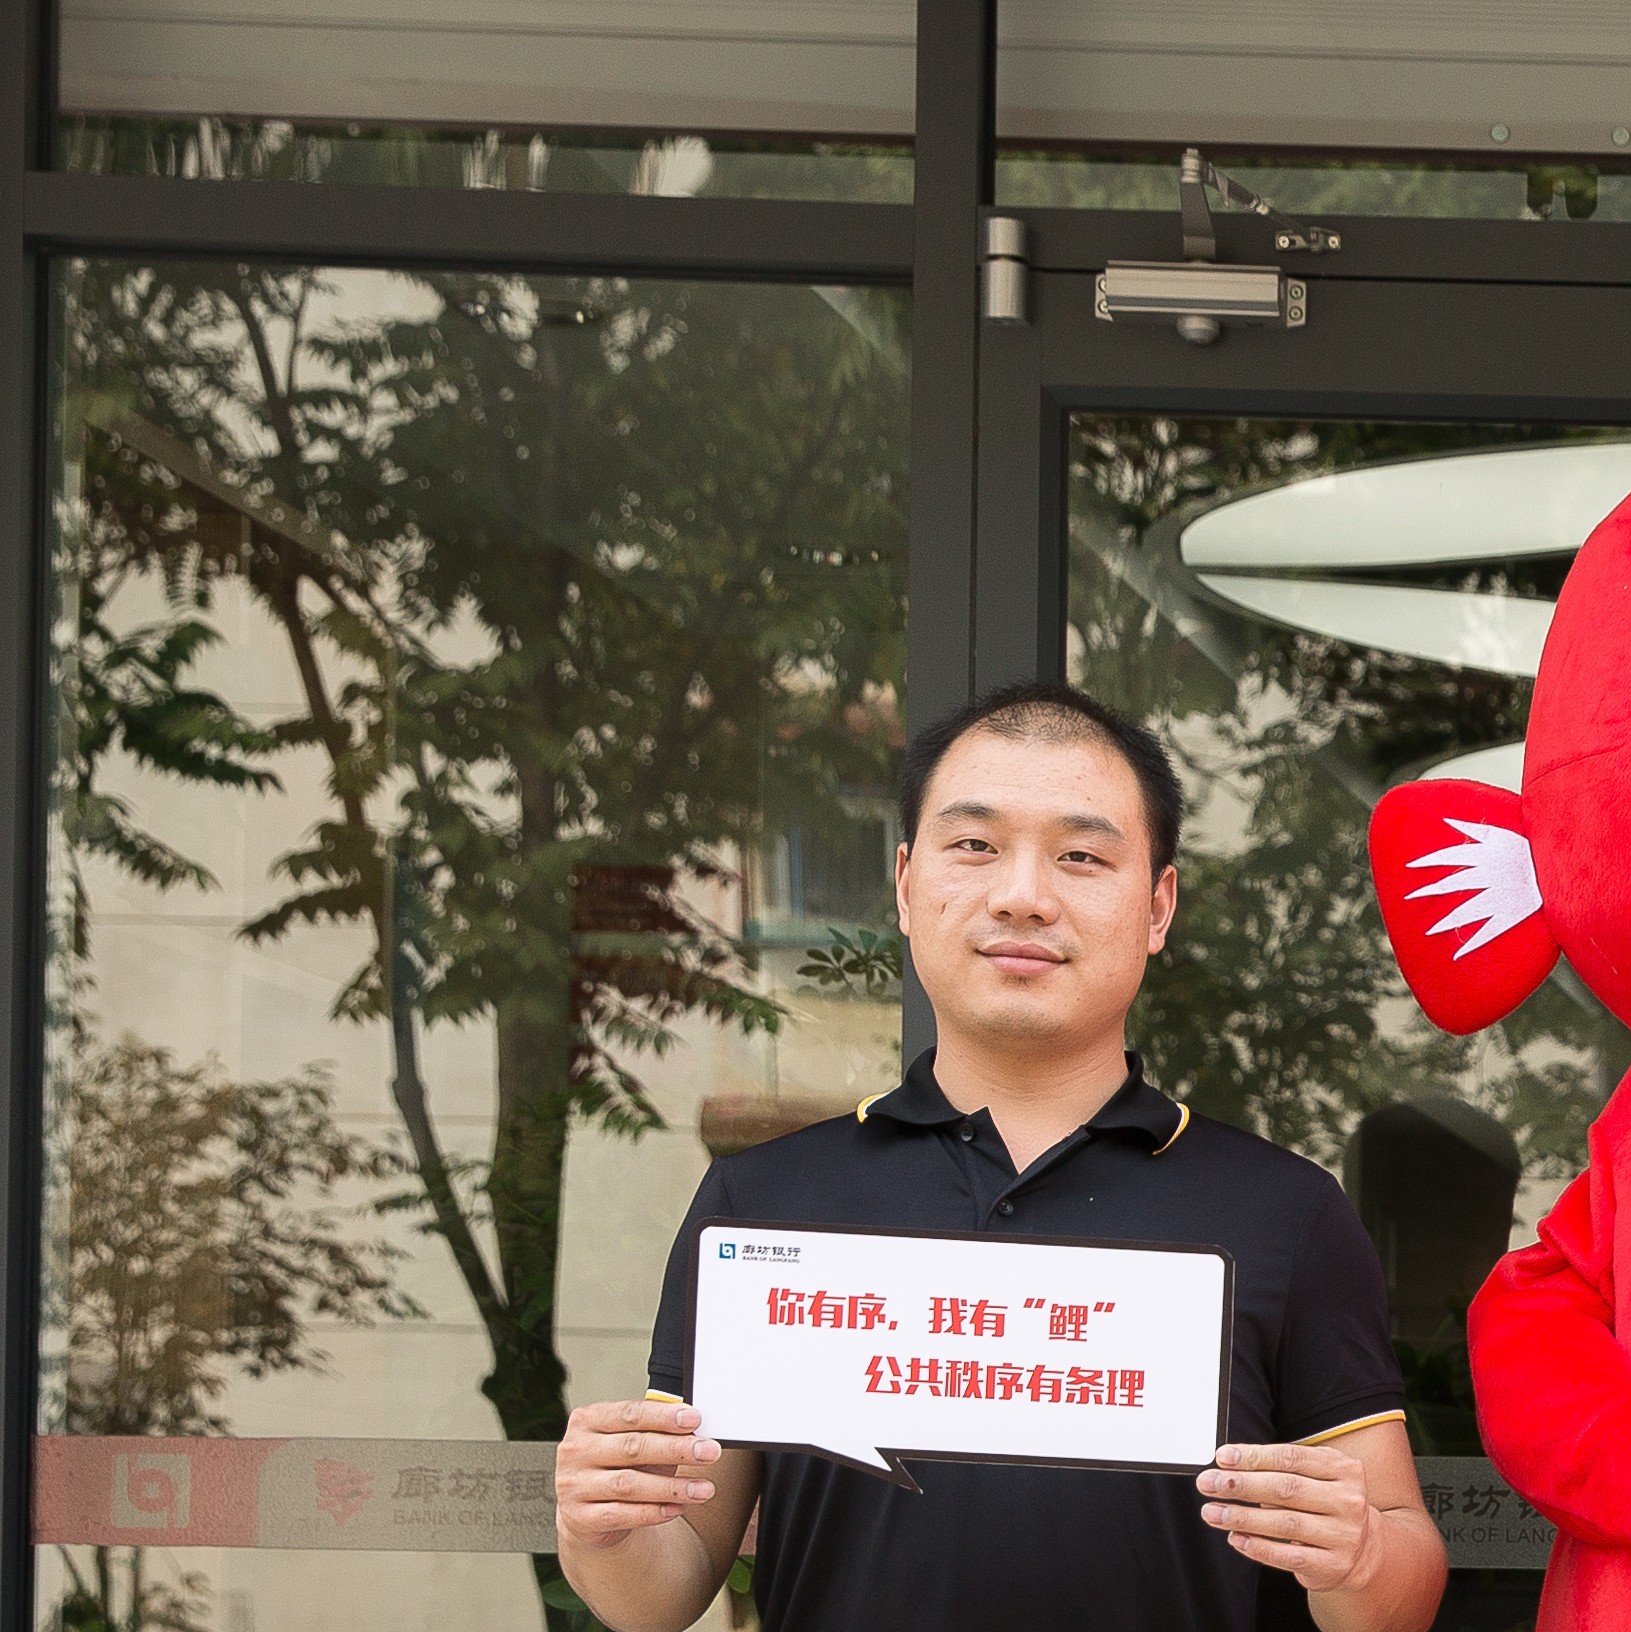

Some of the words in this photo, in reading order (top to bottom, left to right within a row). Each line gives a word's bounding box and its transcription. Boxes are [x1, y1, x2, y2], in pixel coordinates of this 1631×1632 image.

[742, 1244, 801, 1257] 廊坊银行
[864, 1355, 1145, 1408] 公共秩序有条理
[393, 1510, 450, 1525] BANK
[458, 1510, 487, 1526] OF
[1471, 1527, 1499, 1543] OF
